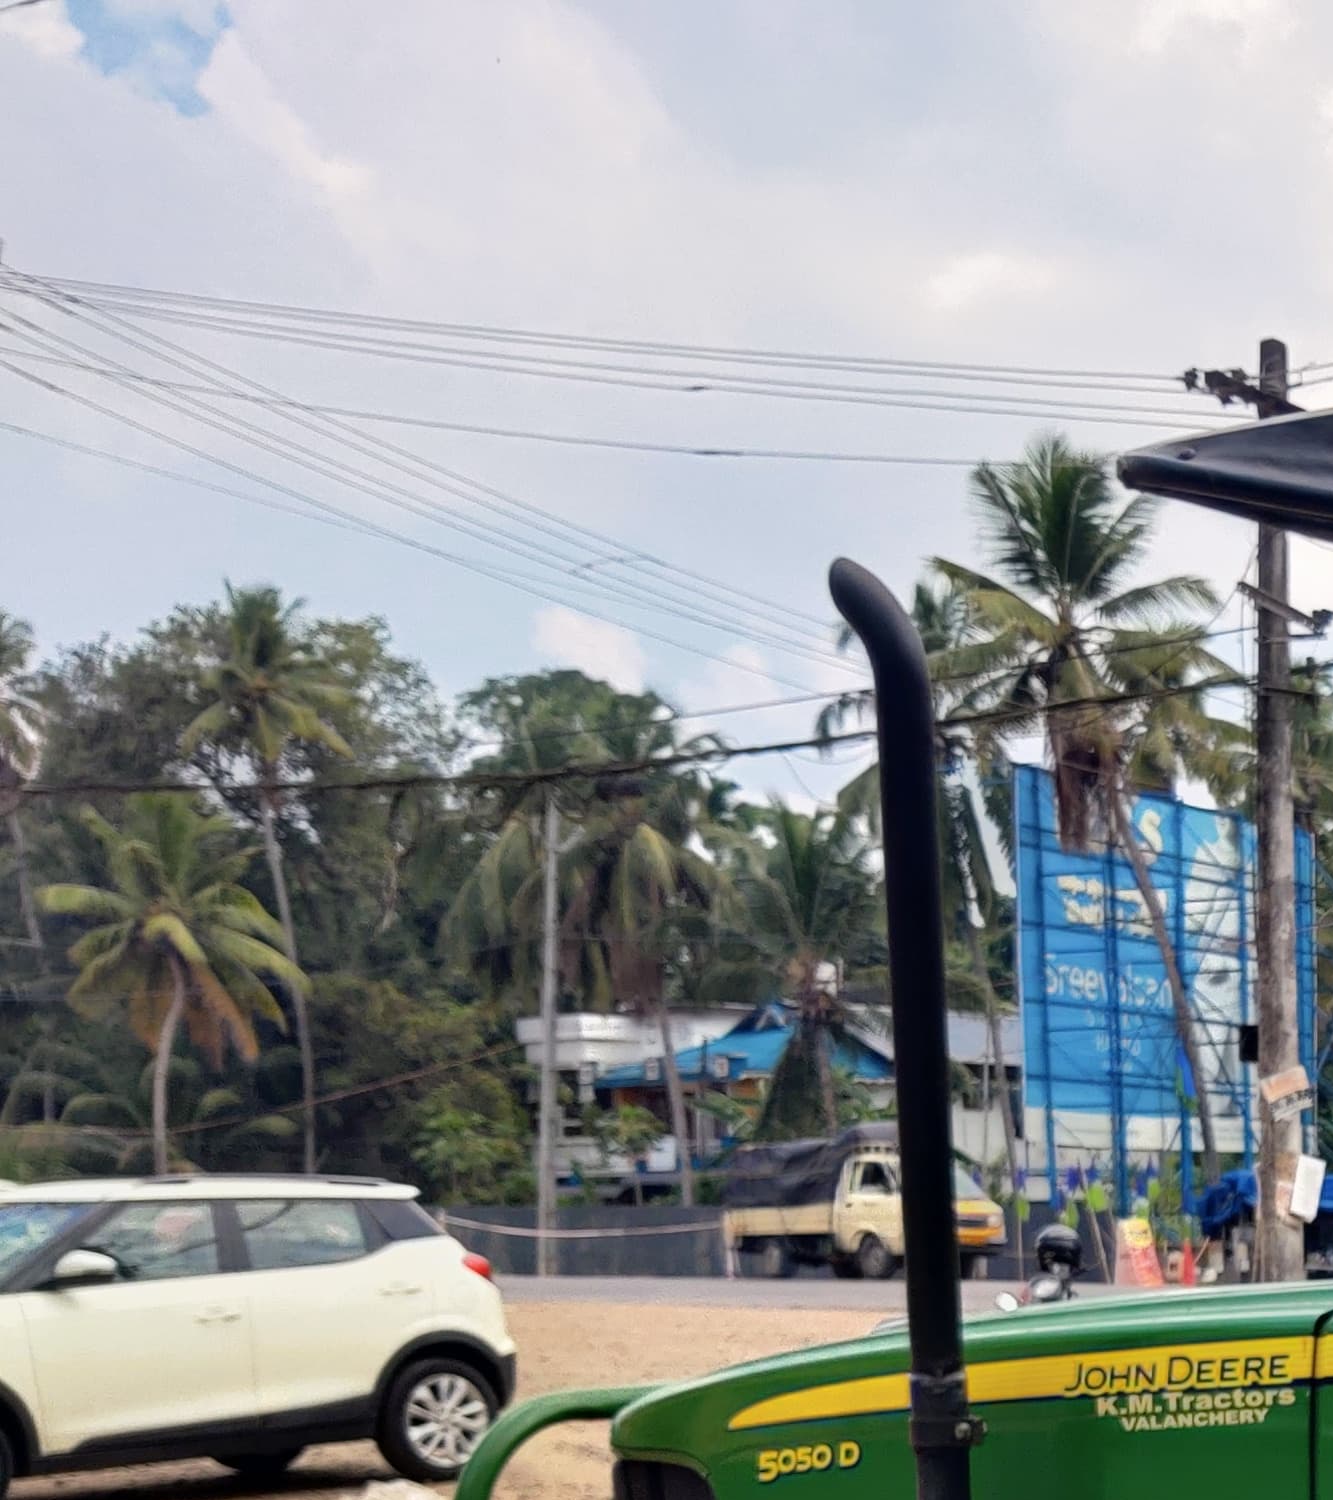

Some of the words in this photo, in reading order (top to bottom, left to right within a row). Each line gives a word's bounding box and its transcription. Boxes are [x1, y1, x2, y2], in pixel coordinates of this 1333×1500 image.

[1063, 1363, 1157, 1392] JOHN
[1167, 1355, 1290, 1386] DEERE
[1096, 1388, 1296, 1417] K.M.Tractors
[1120, 1409, 1269, 1431] VALANCHERY
[758, 1443, 832, 1482] 5050
[839, 1441, 860, 1468] D
